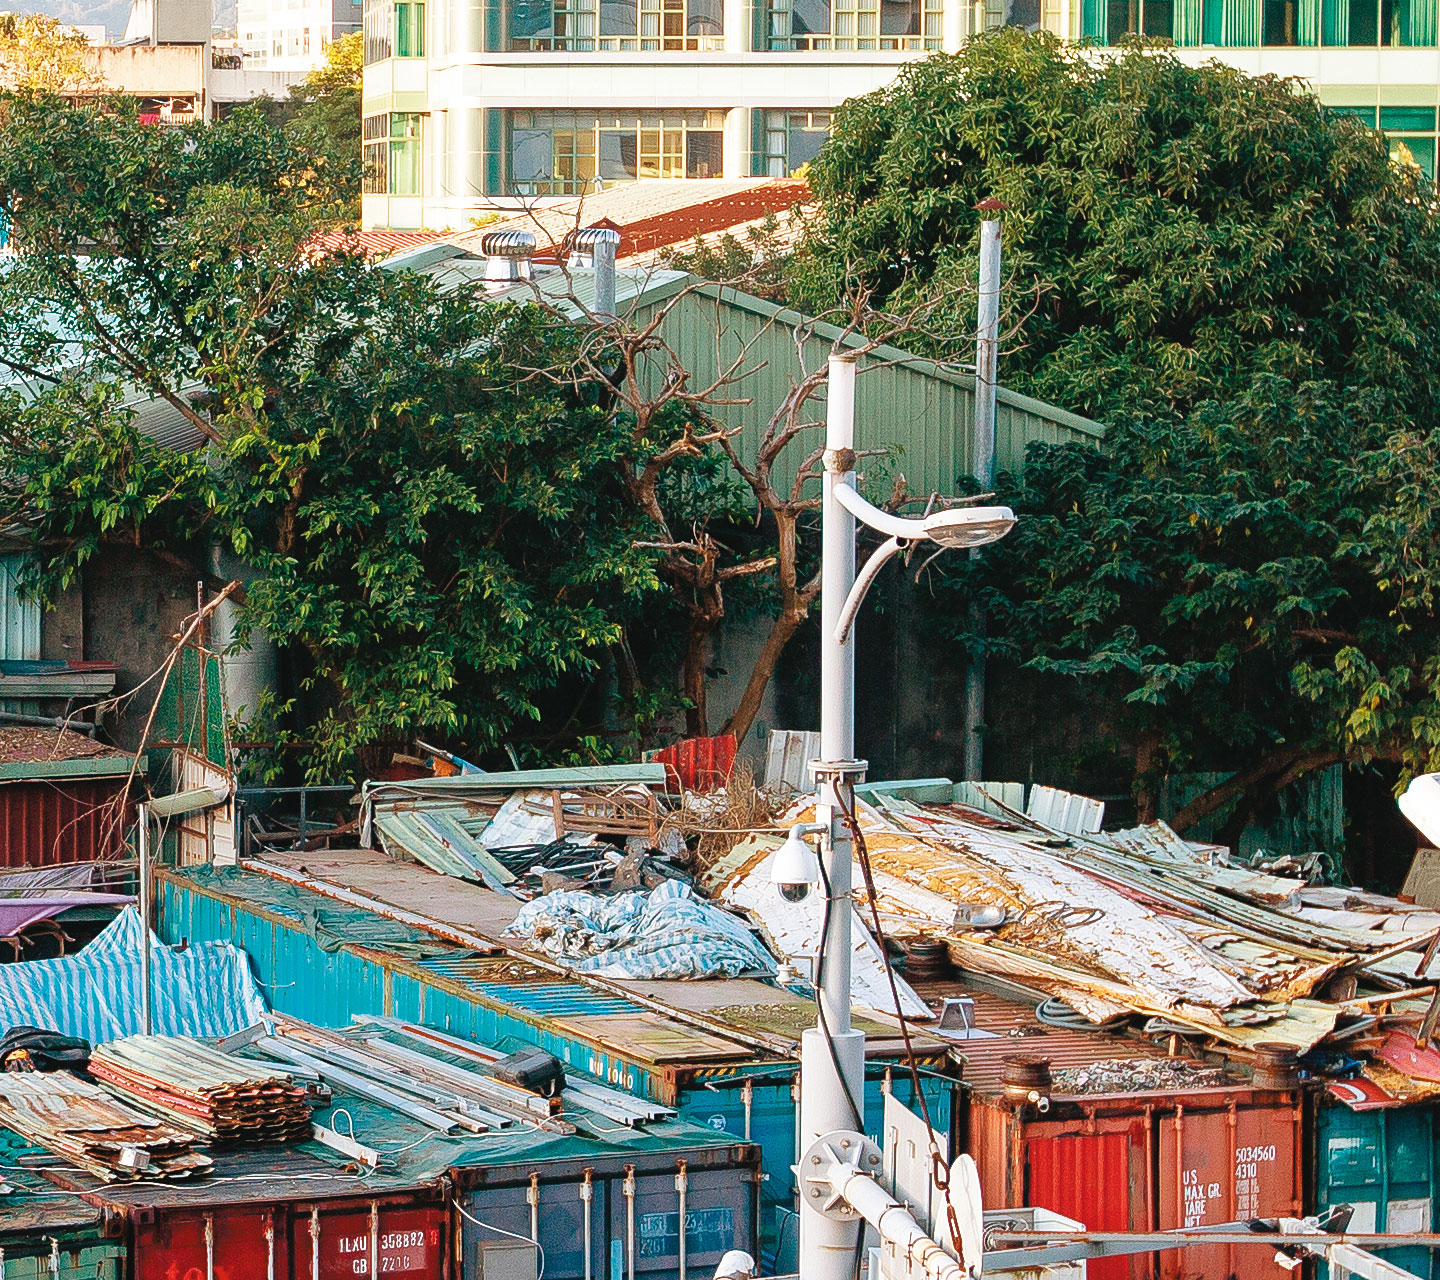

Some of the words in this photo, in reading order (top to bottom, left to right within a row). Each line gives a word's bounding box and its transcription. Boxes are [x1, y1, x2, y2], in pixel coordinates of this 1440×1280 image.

[1235, 1162, 1257, 1179] 4310
[1184, 1184, 1206, 1201] MAX.
[1184, 1200, 1207, 1216] TARE
[1184, 1215, 1201, 1227] NET
[352, 1259, 368, 1274] GB
